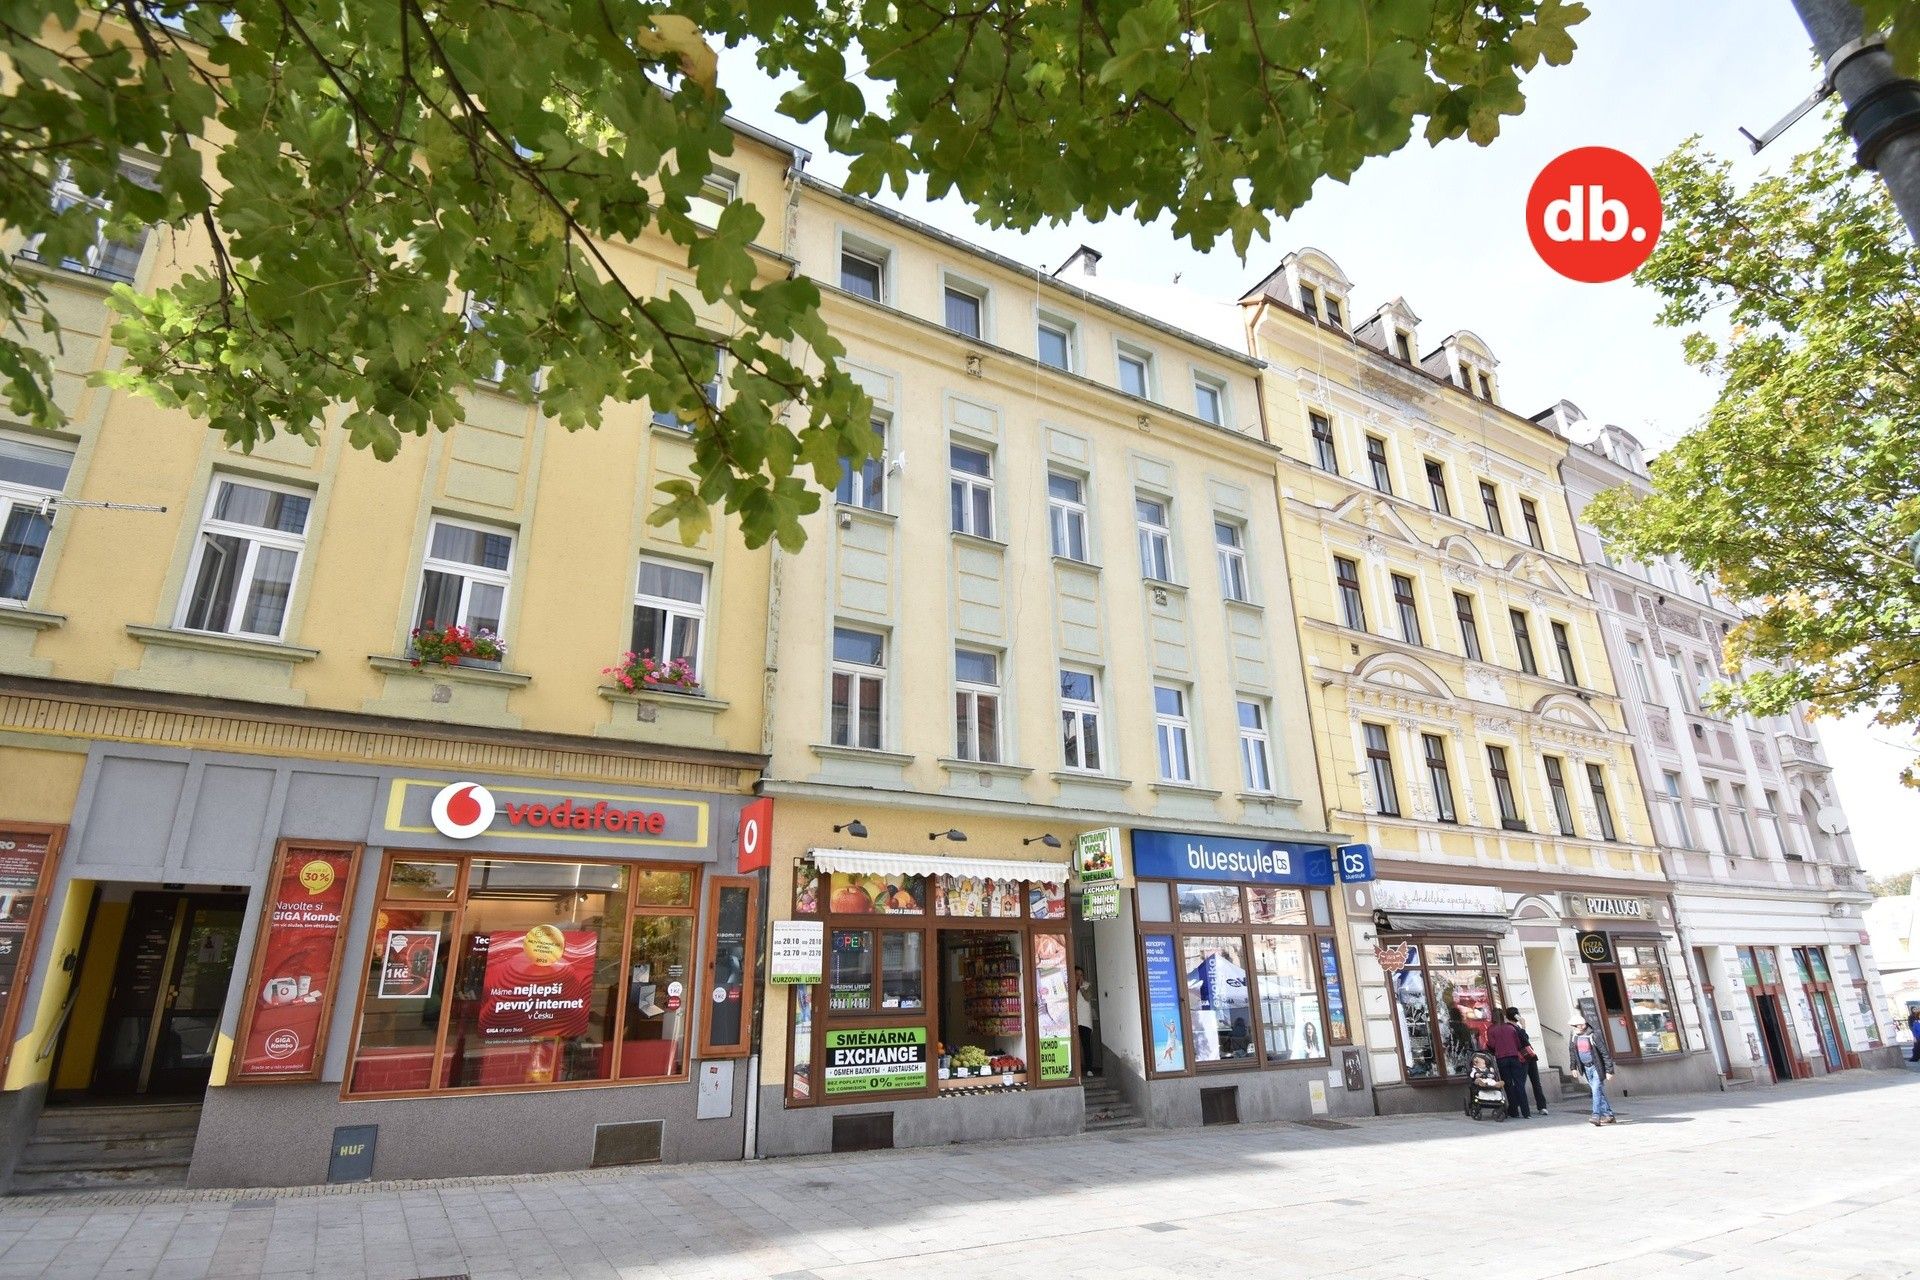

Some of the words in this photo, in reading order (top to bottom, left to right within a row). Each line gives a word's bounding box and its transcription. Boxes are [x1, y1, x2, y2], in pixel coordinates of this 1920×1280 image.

[505, 799, 666, 835] vodafone
[1187, 843, 1273, 878] bluestyle
[1342, 849, 1365, 874] bs
[1083, 885, 1117, 895] EXCHANGE
[277, 901, 313, 911] Navolte
[315, 903, 324, 911] si
[1585, 898, 1616, 914] PIZZA
[1614, 899, 1641, 917] LUGO
[273, 911, 300, 921] GIGA
[1585, 946, 1605, 954] LUGO
[394, 966, 409, 978] Kč
[513, 983, 562, 997] nejlepší
[495, 998, 534, 1013] pevný
[535, 999, 584, 1009] internet
[533, 1011, 554, 1020] Česku
[836, 1031, 917, 1046] SMĚNÁRNA
[1040, 1040, 1058, 1050] VCHOD
[834, 1046, 918, 1066] EXCHANGE
[1041, 1054, 1056, 1063] ВХОД
[833, 1068, 855, 1076] ОБМЕН
[855, 1066, 880, 1074] ВАЛЮТЫ
[887, 1064, 919, 1073] AUSTAUSCH
[1041, 1064, 1069, 1076] ENTRANCE
[869, 1077, 893, 1088] 0%
[340, 1144, 365, 1156] HUP
